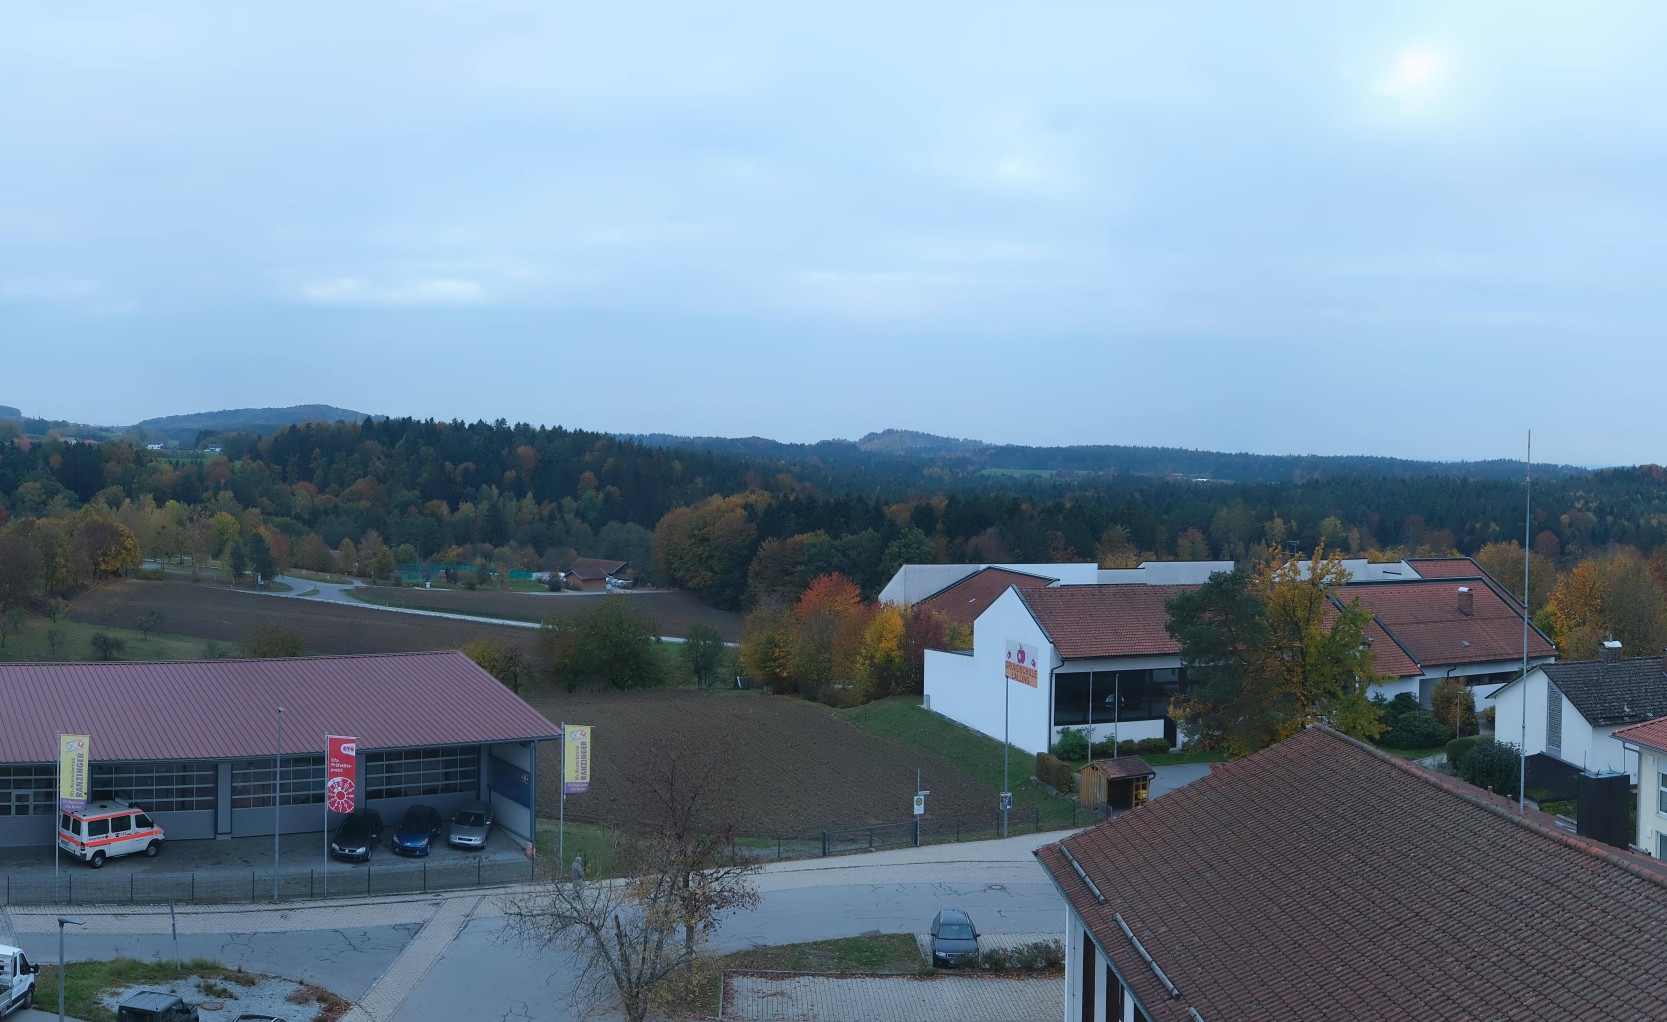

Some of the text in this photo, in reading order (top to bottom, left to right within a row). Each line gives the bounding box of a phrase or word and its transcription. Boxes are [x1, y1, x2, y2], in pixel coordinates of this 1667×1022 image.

[1005, 661, 1038, 679] GRUNDSCHULE
[76, 752, 85, 798] RANZINGER
[580, 741, 588, 781] RANZINGER
